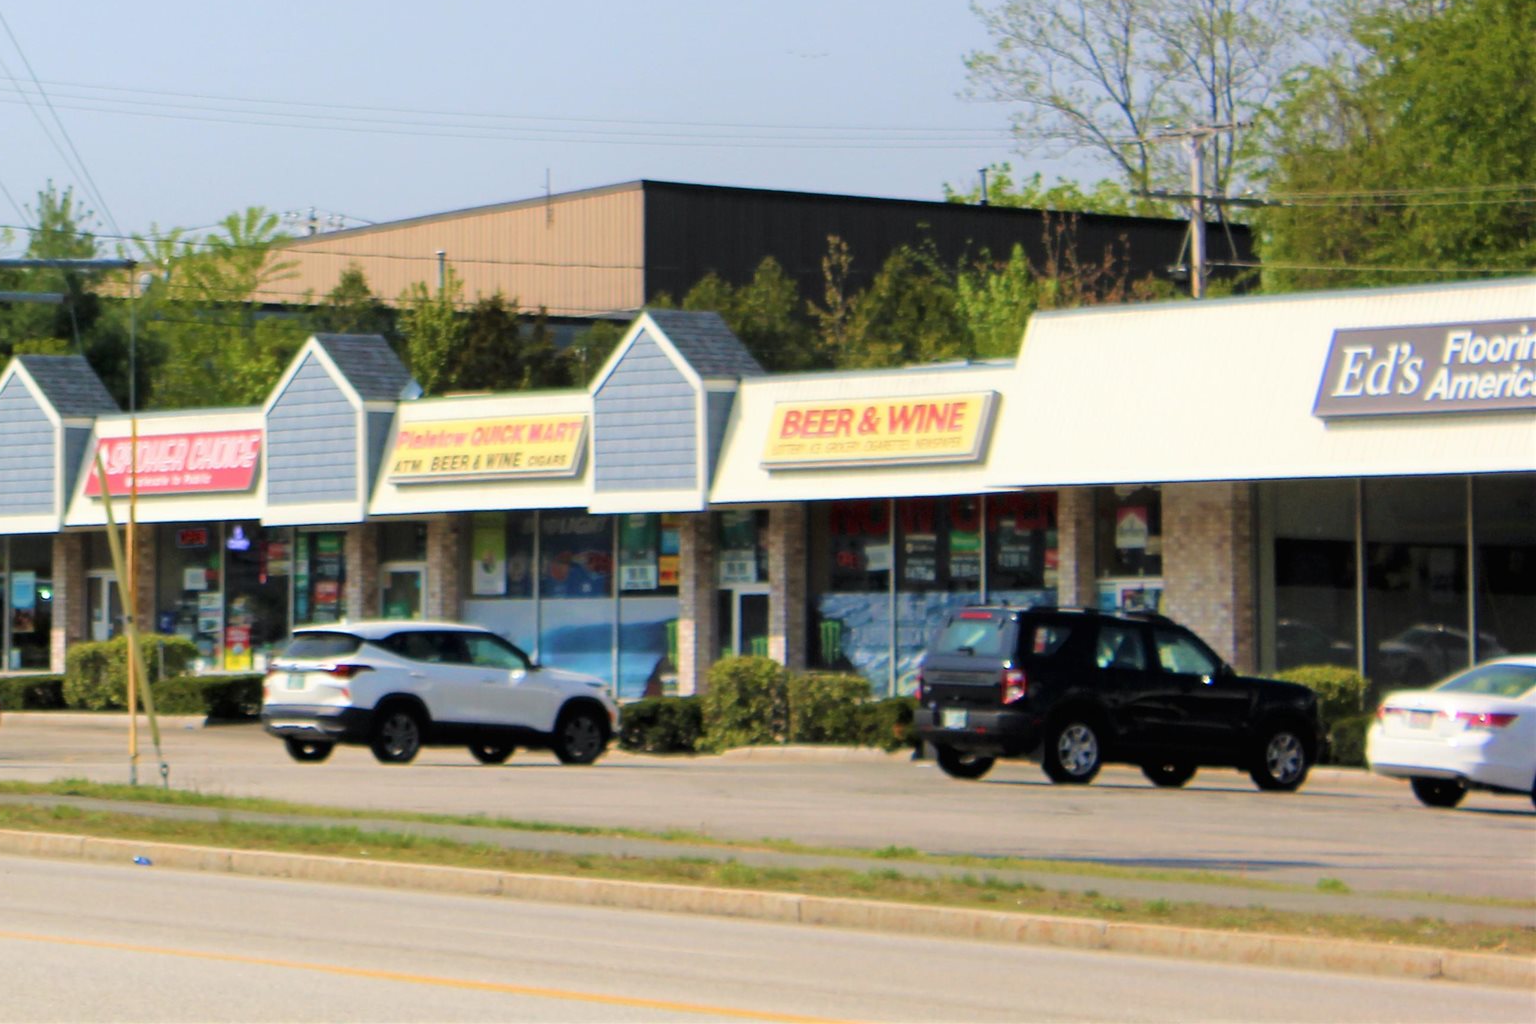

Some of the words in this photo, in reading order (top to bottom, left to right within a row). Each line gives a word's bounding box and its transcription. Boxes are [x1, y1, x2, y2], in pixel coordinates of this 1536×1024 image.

[1331, 342, 1424, 397] Ed's
[780, 408, 855, 439] BEER
[857, 406, 881, 435] &
[888, 402, 967, 434] WINE
[394, 459, 423, 472] ATM
[430, 455, 470, 471] BEER
[486, 452, 523, 467] WINE
